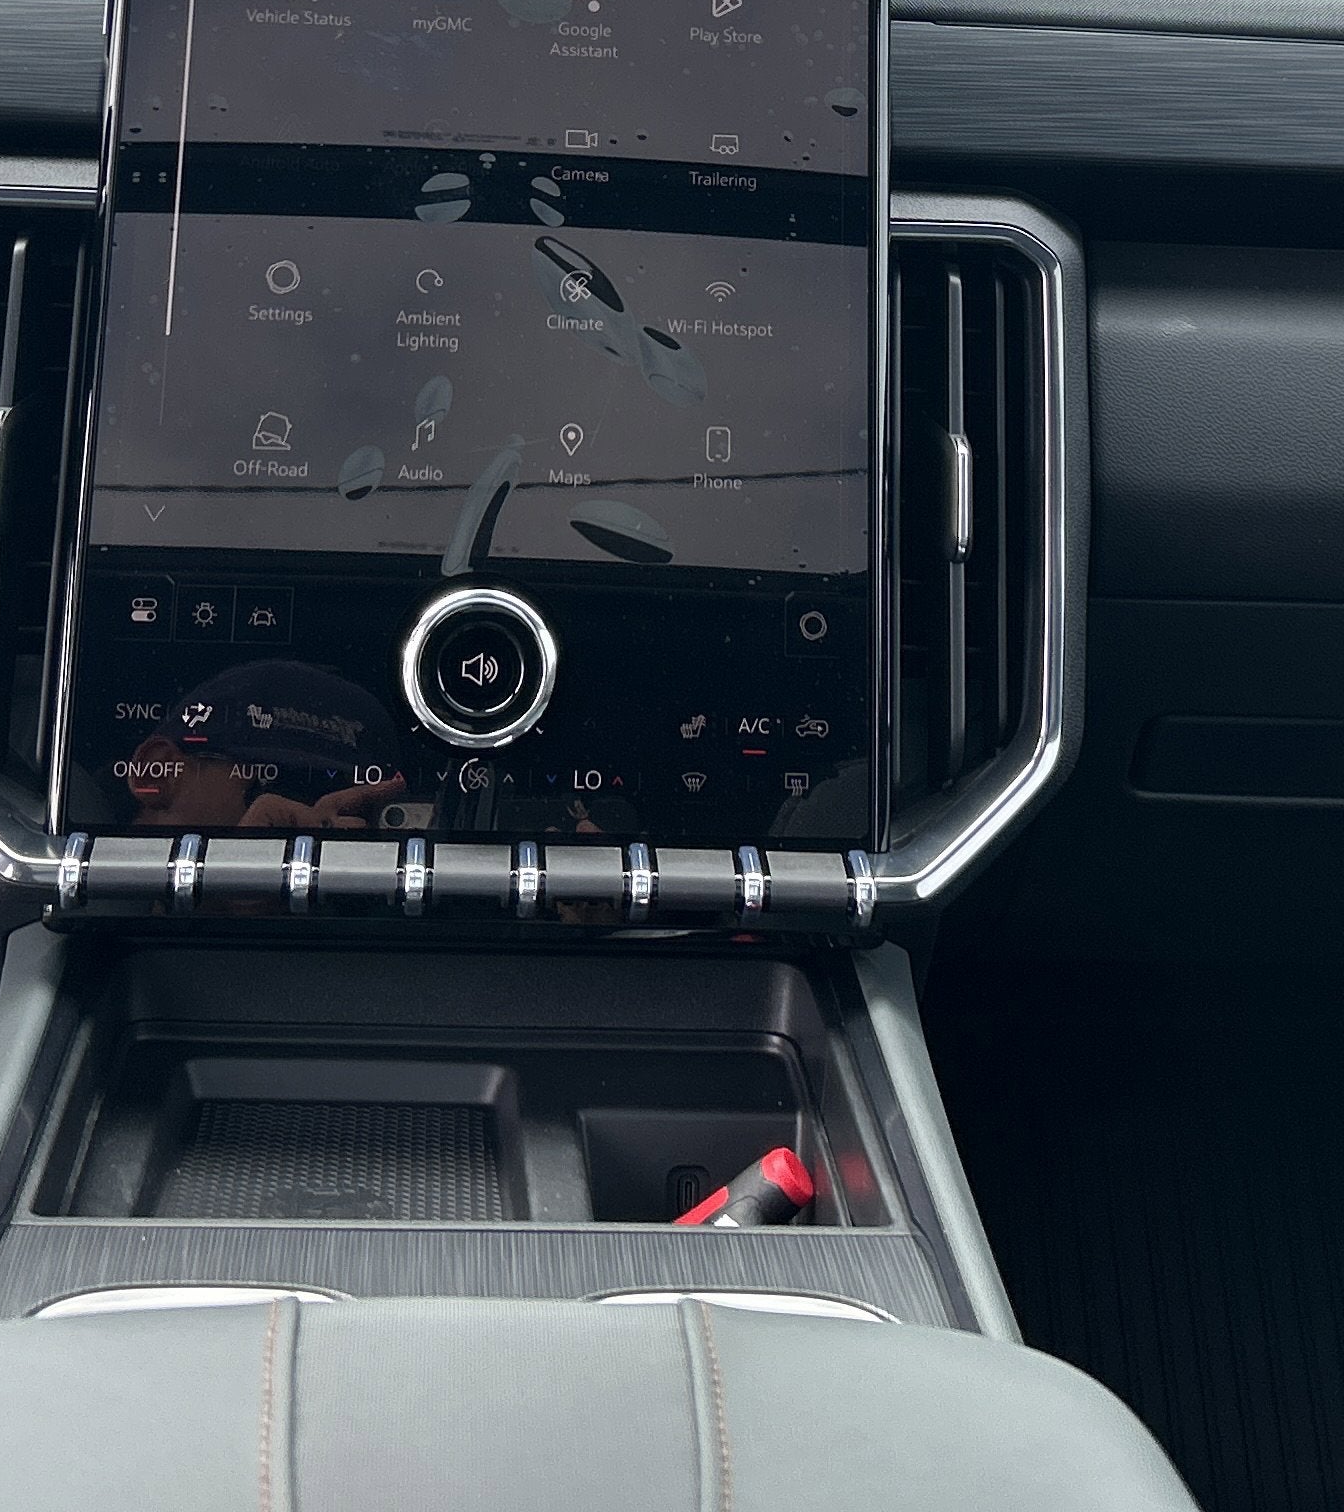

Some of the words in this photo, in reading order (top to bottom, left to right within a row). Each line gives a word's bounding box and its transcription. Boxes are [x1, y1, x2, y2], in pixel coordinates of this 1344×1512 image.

[246, 9, 299, 24] Vehicle
[303, 10, 352, 27] Status
[413, 16, 472, 34] myGMC
[558, 22, 612, 40] Google
[690, 27, 720, 45] Play
[723, 27, 762, 44] Store
[549, 42, 618, 59] Assistant
[551, 166, 609, 182] Camera
[689, 171, 757, 191] Trailering
[248, 305, 313, 326] Settings
[396, 310, 461, 327] Ambient
[546, 314, 604, 331] Climate
[667, 319, 706, 334] Wi-Fi
[711, 319, 773, 340] Hotspot
[396, 332, 459, 353] Lighting
[233, 460, 308, 477] Off-Road
[398, 464, 443, 481] Audio
[549, 469, 591, 488] Maps
[693, 472, 743, 489] Phone
[115, 703, 161, 720] SYNC
[738, 717, 770, 735] A/C
[113, 761, 185, 779] ON/OFF
[229, 764, 278, 780] AUTO
[353, 765, 382, 785] LO
[574, 770, 602, 789] LO
